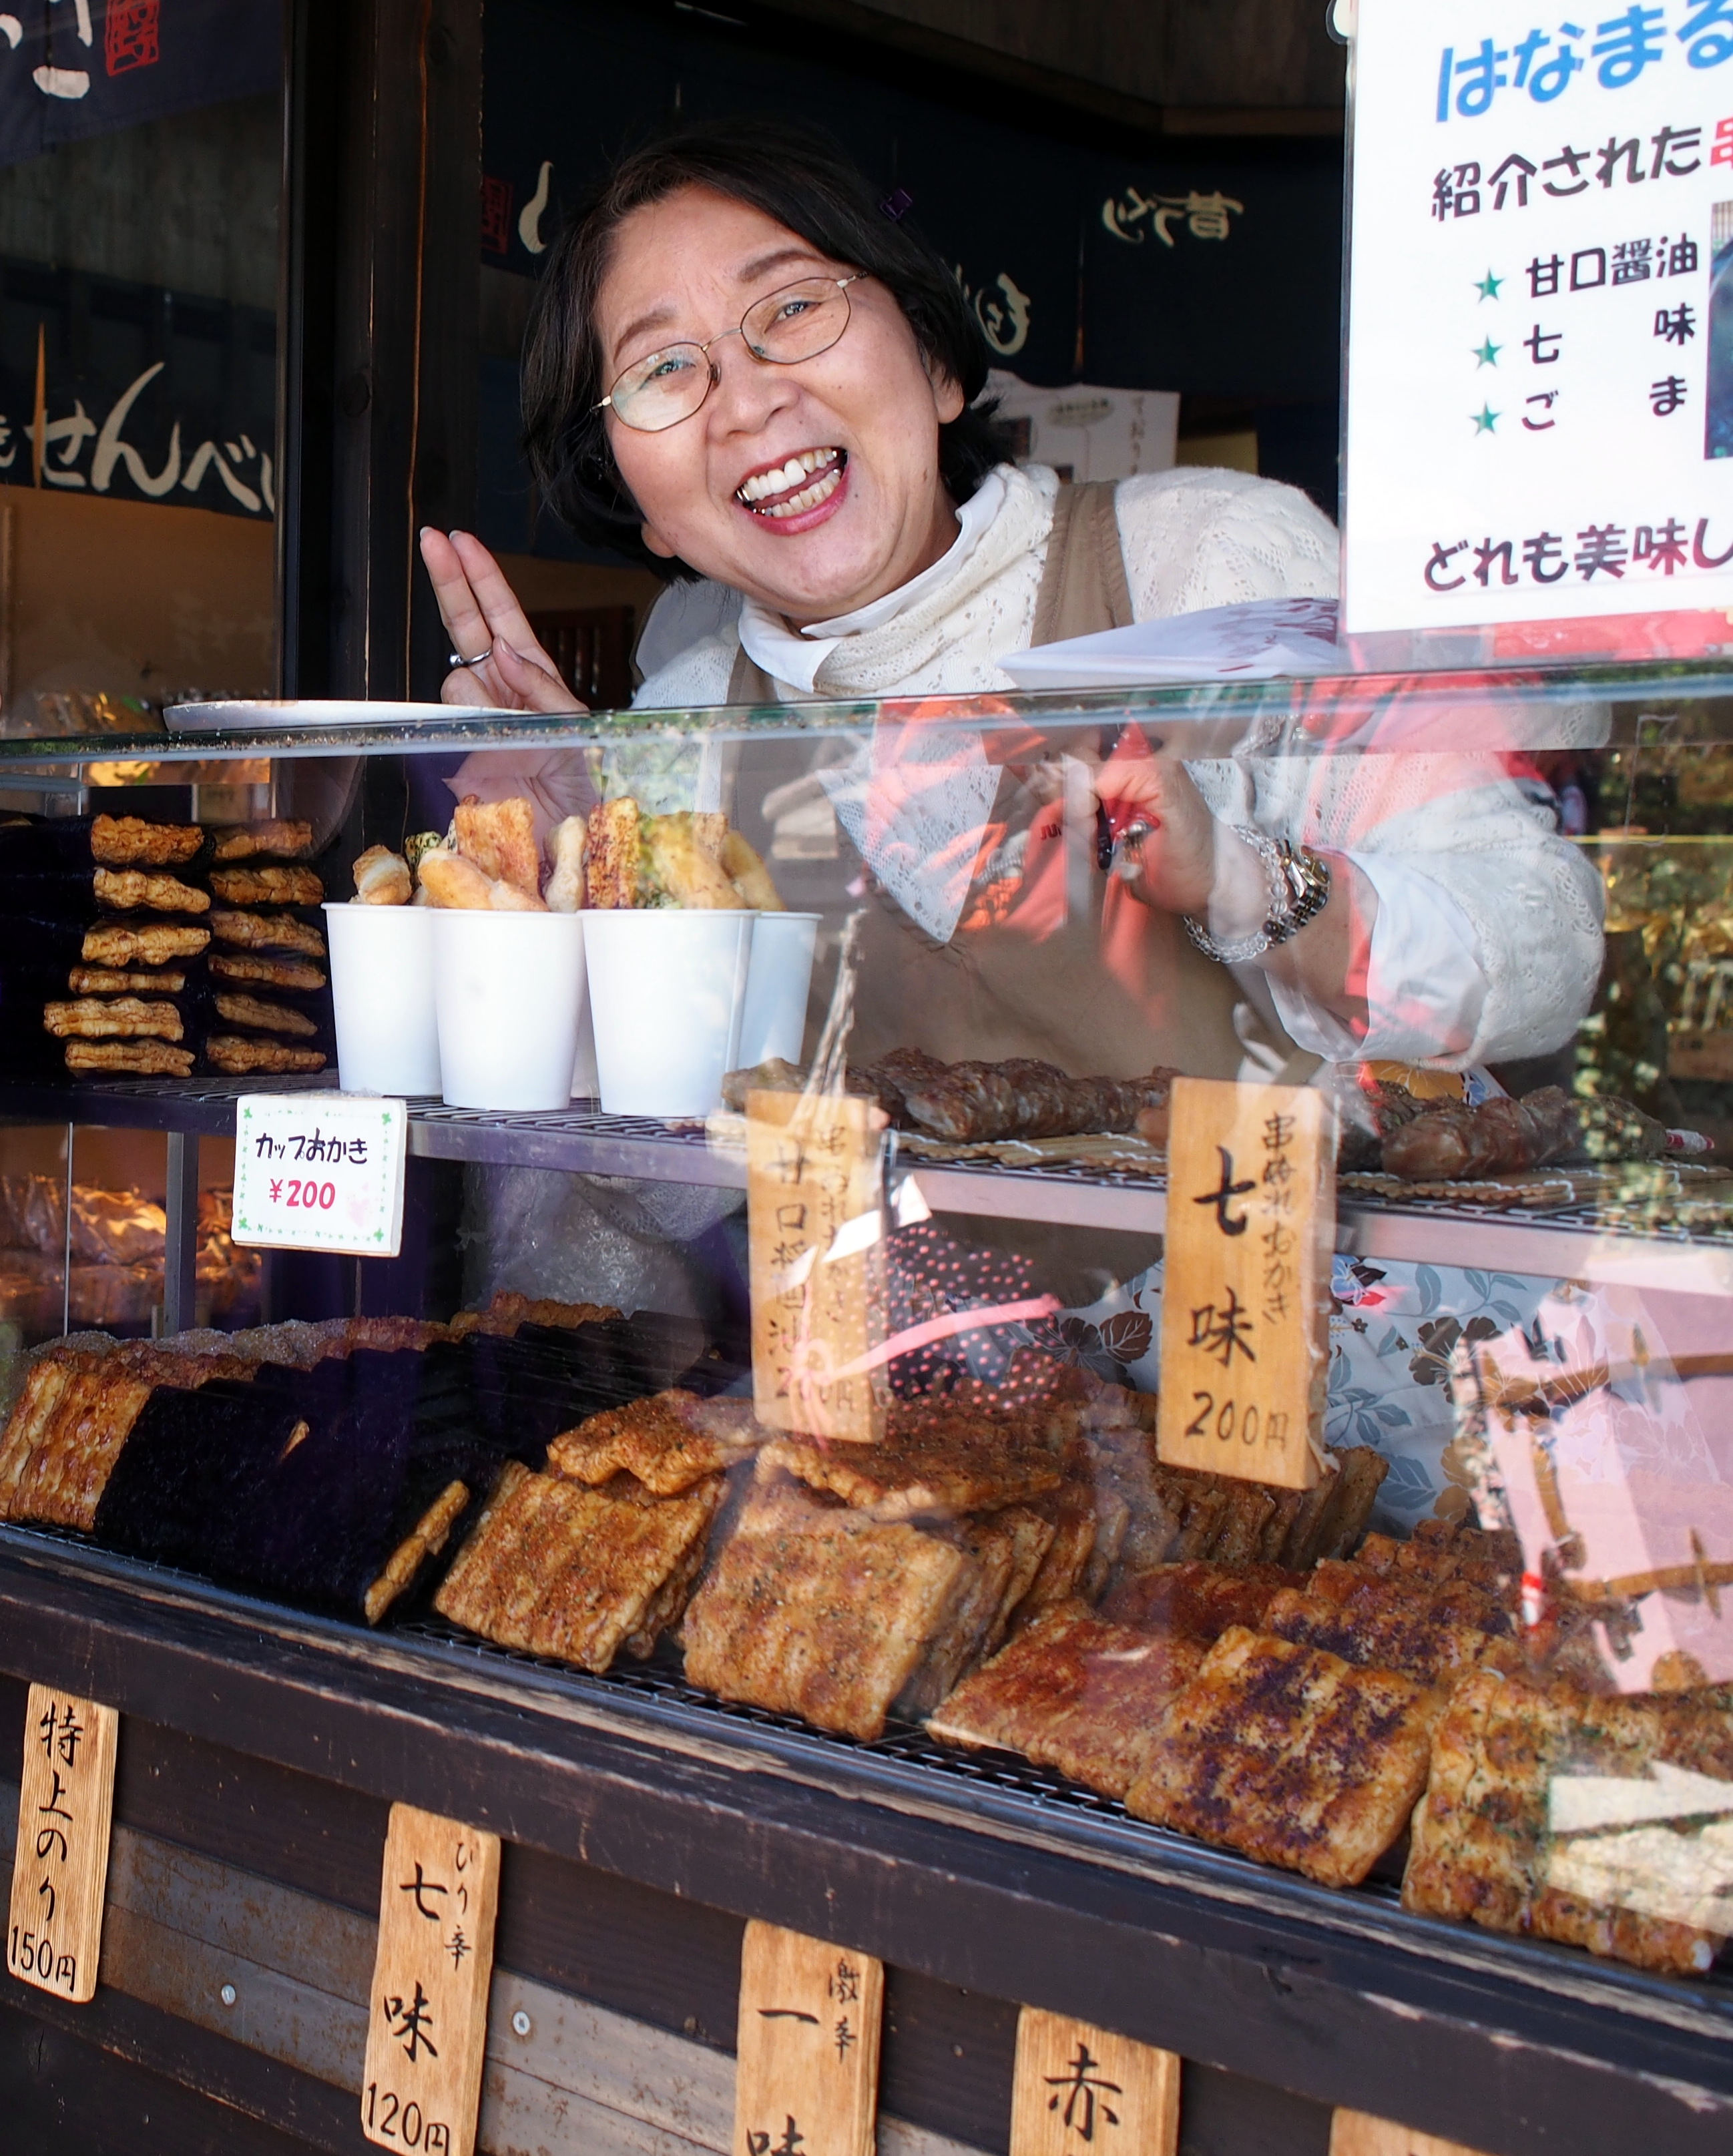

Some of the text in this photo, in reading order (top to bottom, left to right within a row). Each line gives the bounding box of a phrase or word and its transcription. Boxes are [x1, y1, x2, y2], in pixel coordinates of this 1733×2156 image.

[1435, 0, 1733, 123] はなまる
[1525, 232, 1698, 299] 甘口醤油
[1423, 517, 1733, 592] どれも美味し
[255, 1127, 368, 1165] カップおかき
[268, 1178, 336, 1209] ¥200
[1187, 1144, 1257, 1368] 七味
[1185, 1390, 1289, 1451] 200円
[37, 1699, 84, 1922] 特上のり
[11, 1925, 77, 1992] 150円
[383, 1861, 449, 2063] 七味
[828, 1957, 860, 2065] 激辛
[367, 2081, 451, 2156] 120円
[1043, 2042, 1123, 2143] 赤
